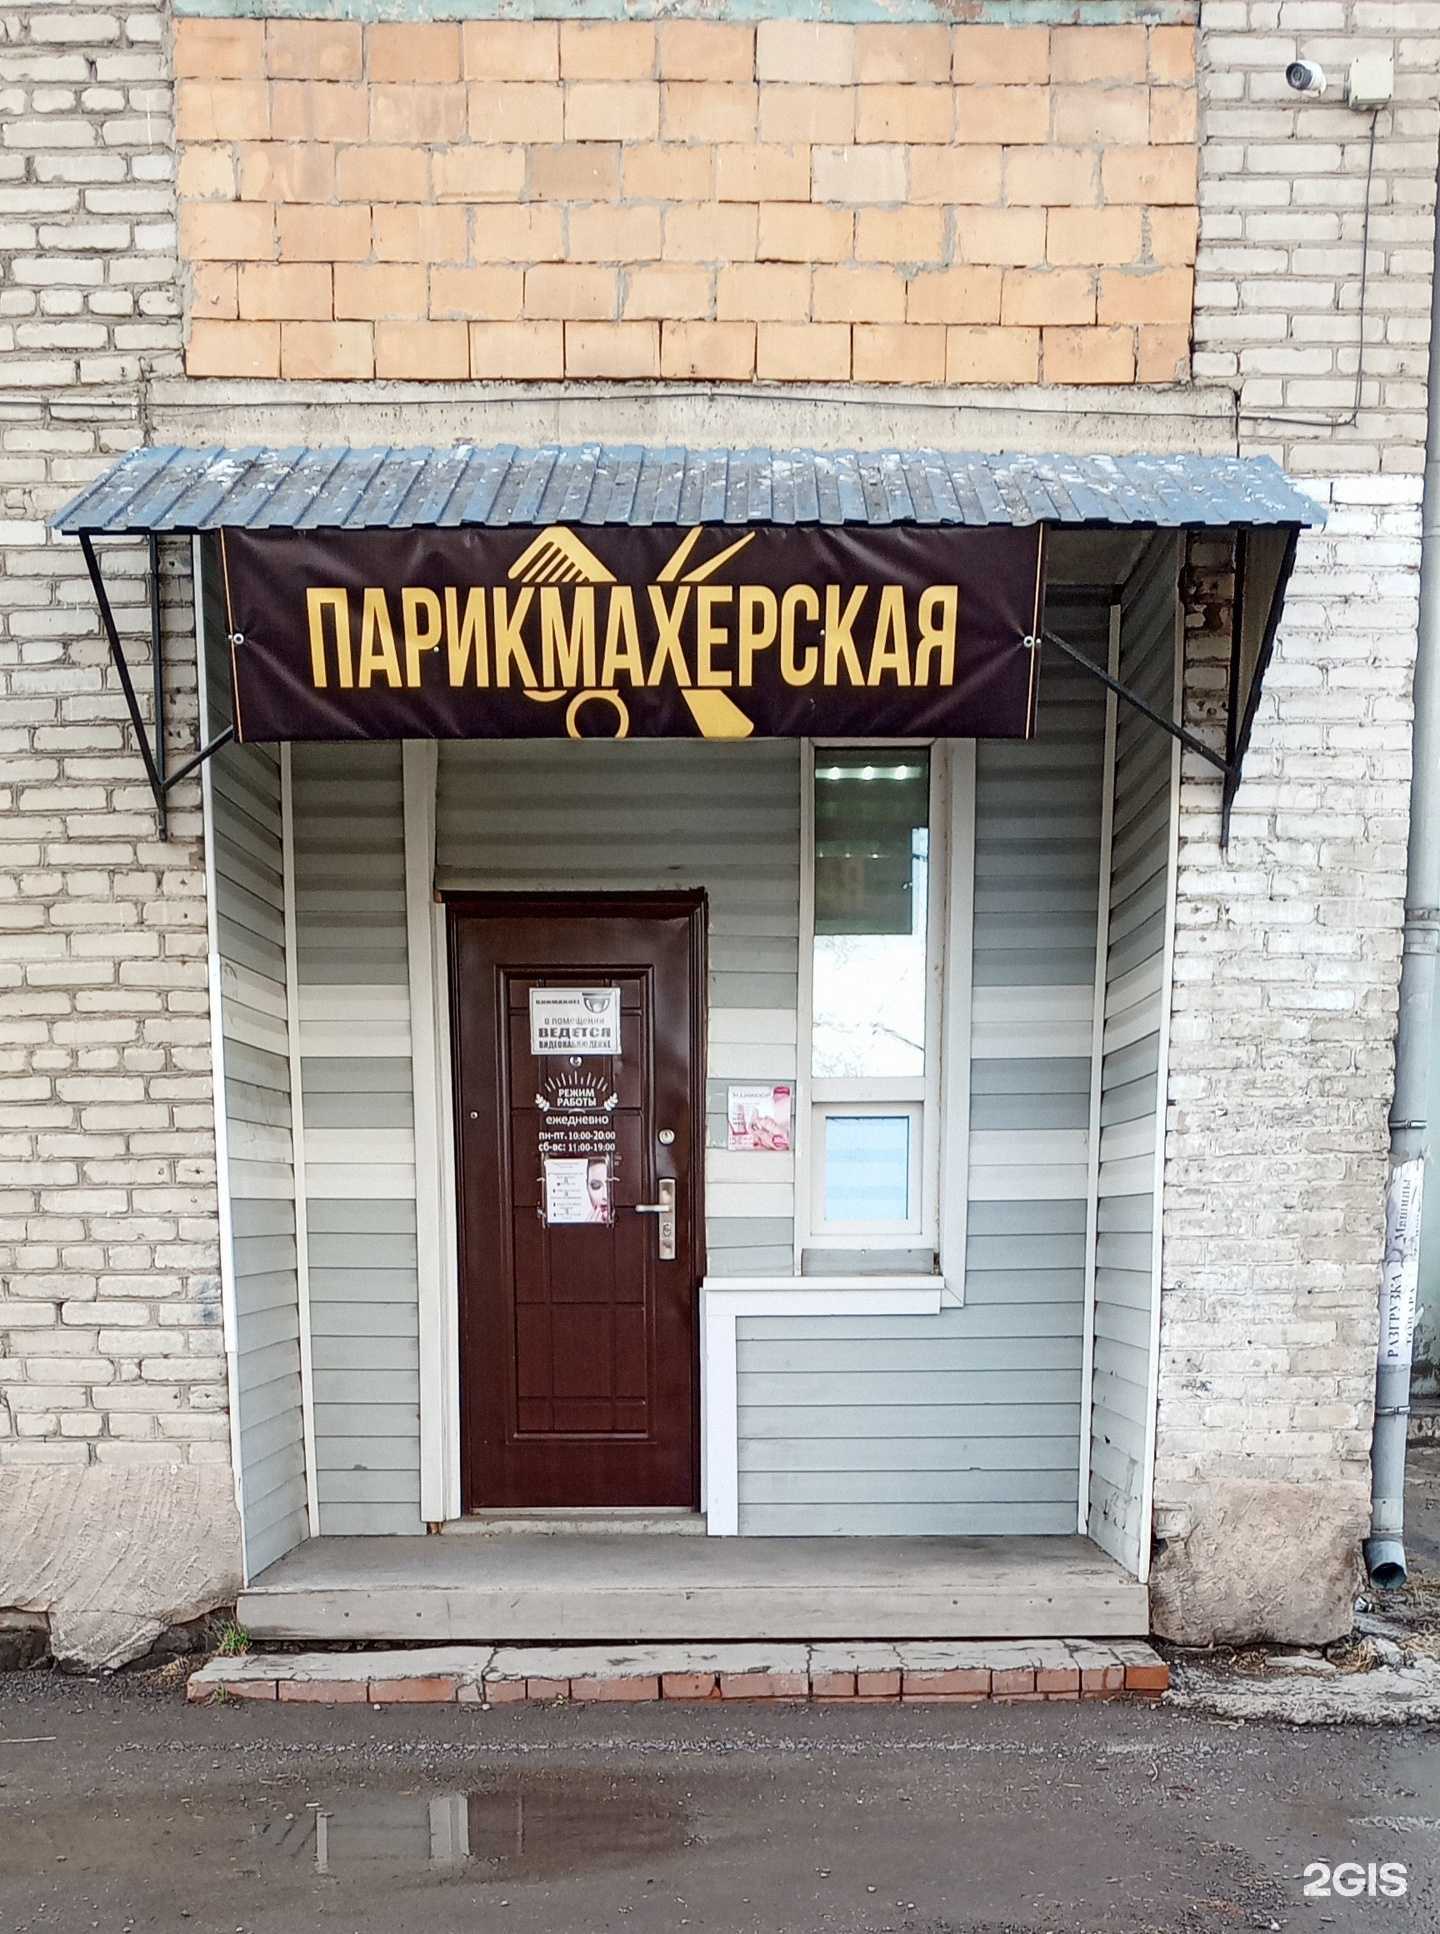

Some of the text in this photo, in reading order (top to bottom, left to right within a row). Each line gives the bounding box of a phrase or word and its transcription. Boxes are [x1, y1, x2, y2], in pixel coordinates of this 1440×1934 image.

[306, 584, 959, 690] ПАРИКМАХЕРСКАЯ
[558, 1088, 595, 1097] РЕЖИМ
[557, 1097, 597, 1107] РАБОТЫ
[545, 1115, 609, 1127] ежедневно
[1387, 1273, 1402, 1358] РАЗГРУЗКА
